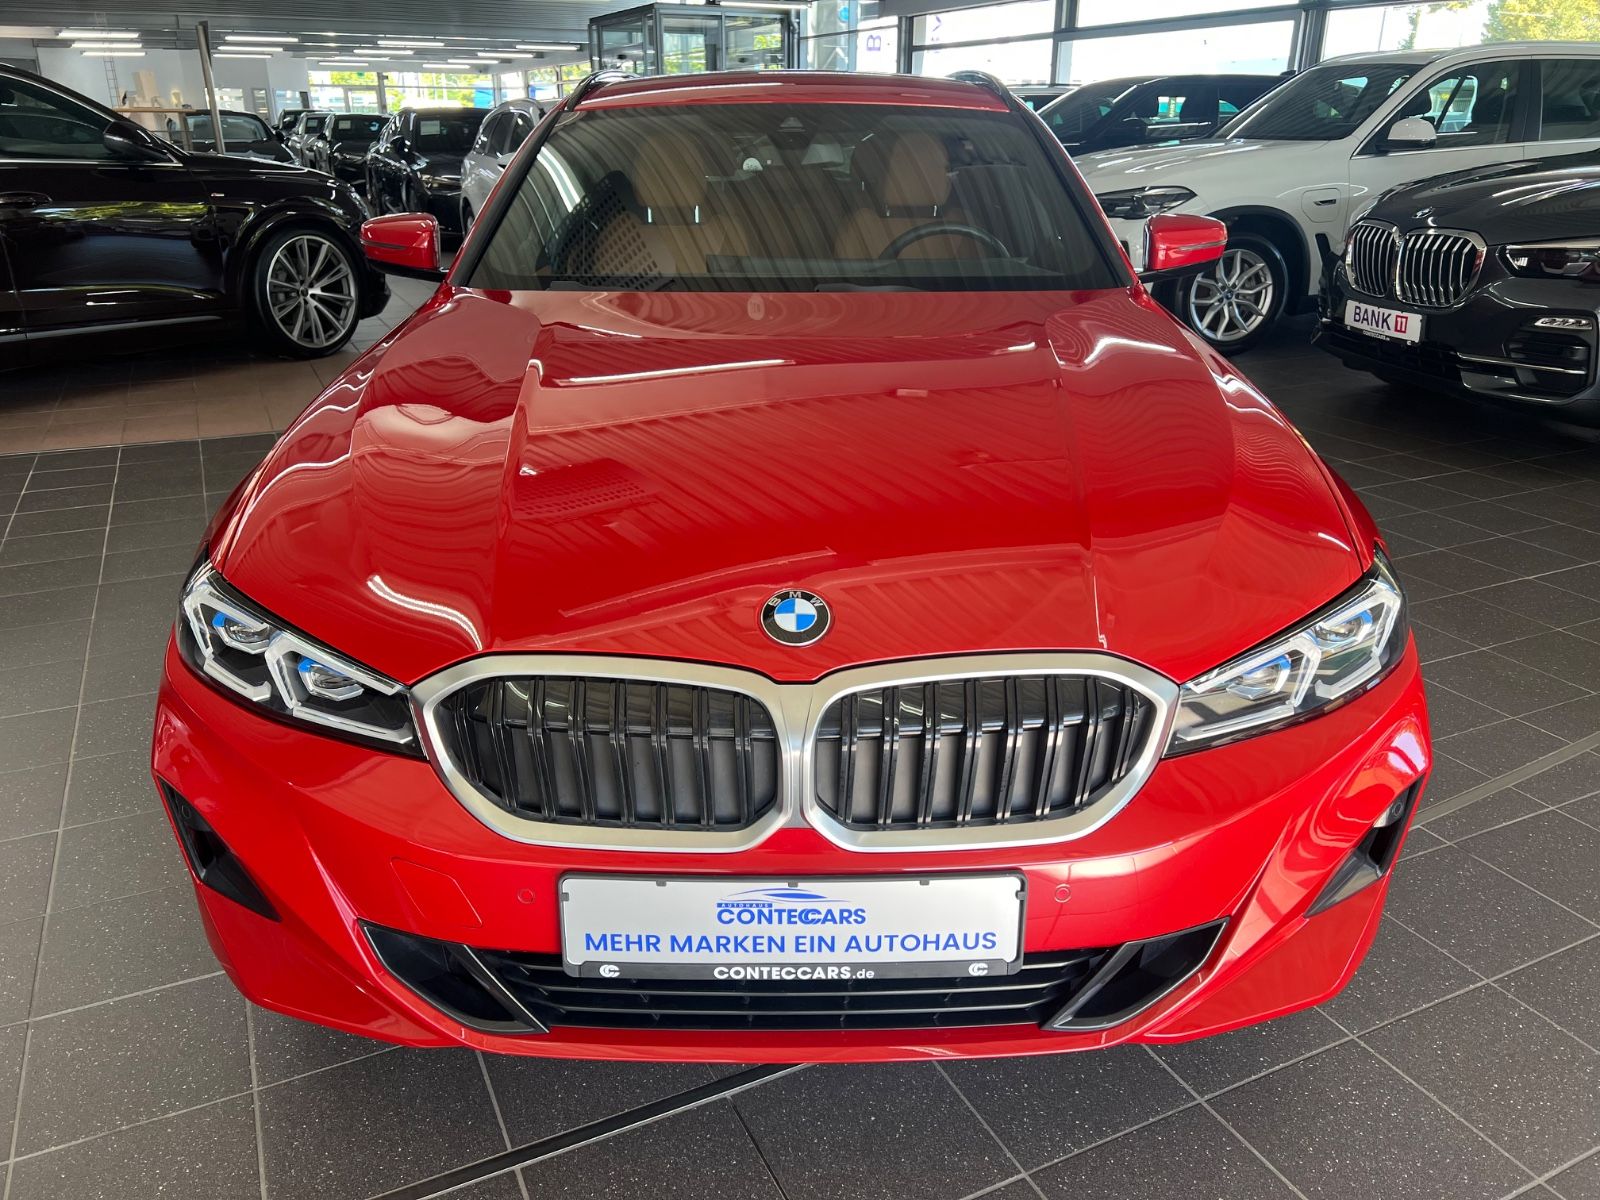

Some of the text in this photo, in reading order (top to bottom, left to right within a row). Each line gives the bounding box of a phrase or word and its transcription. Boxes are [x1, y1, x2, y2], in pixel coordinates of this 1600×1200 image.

[1353, 305, 1392, 331] BANK
[768, 591, 824, 607] BMW
[717, 908, 866, 925] CONTECCARS
[585, 932, 997, 953] MEHR MARKEN EIN AUTOHAUS
[713, 966, 875, 980] CONTECCARS.de
